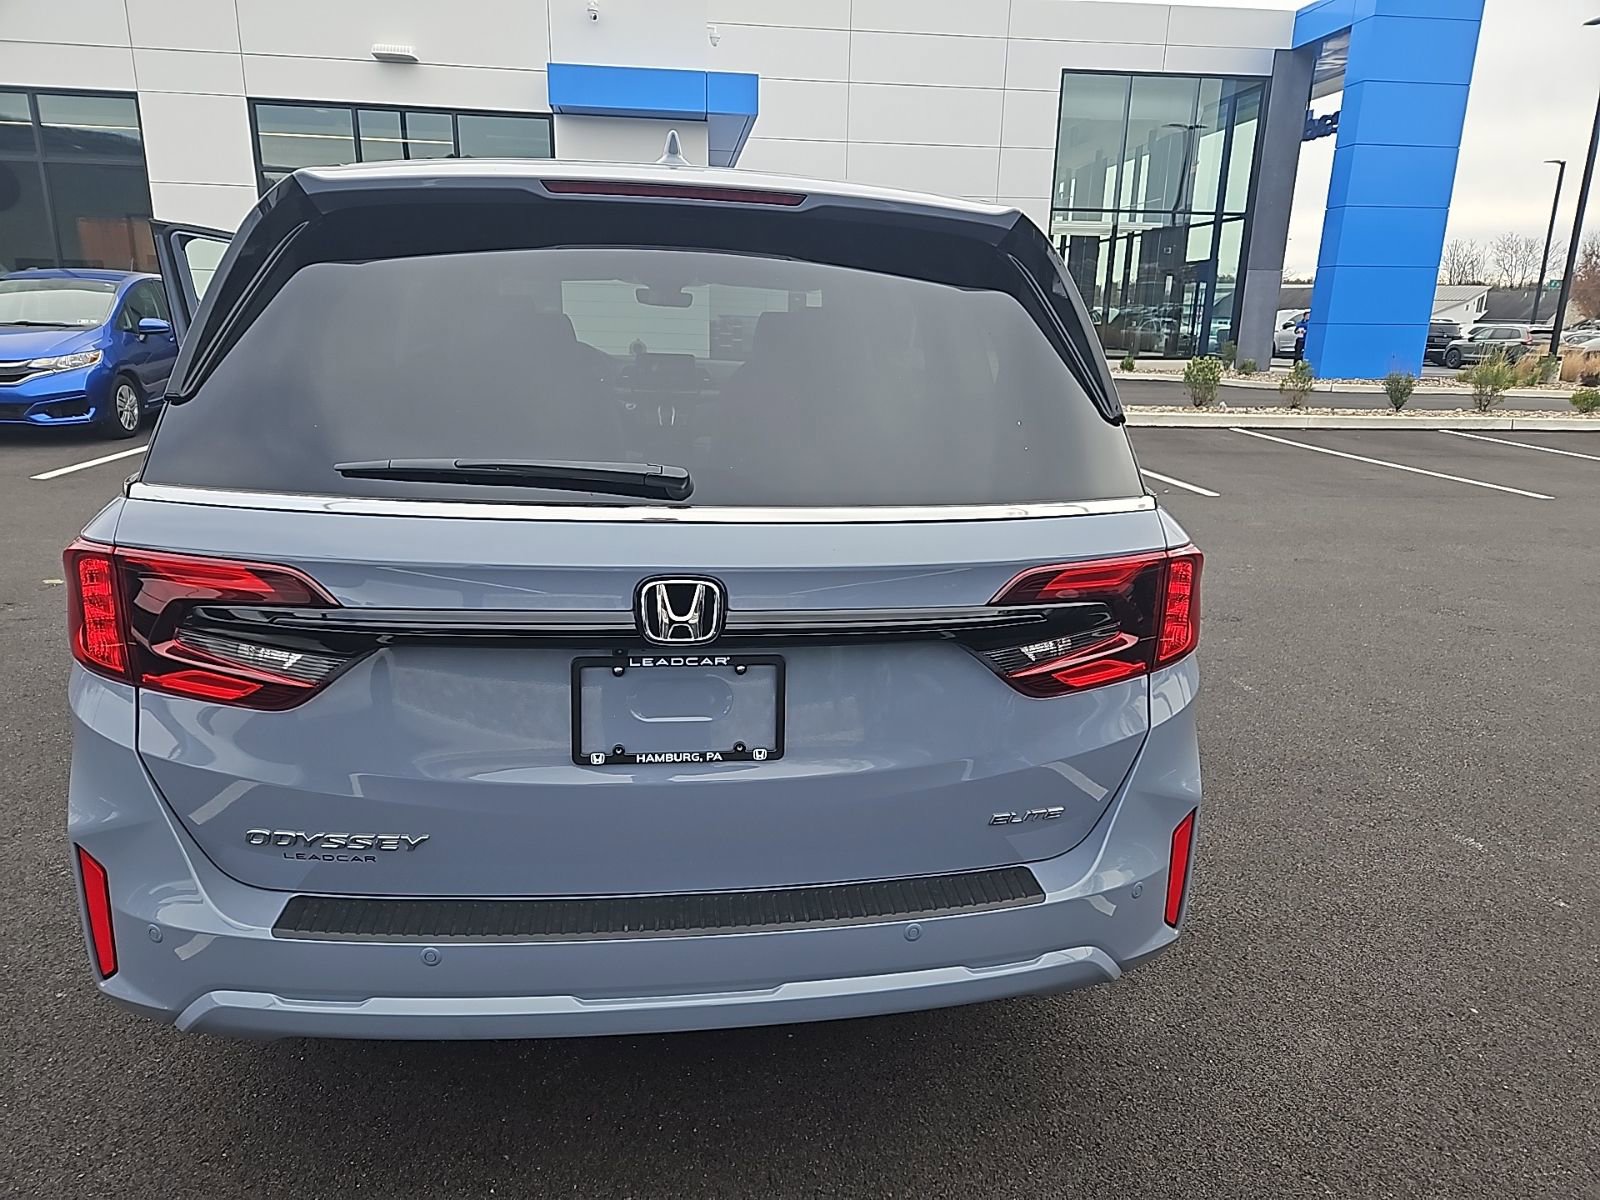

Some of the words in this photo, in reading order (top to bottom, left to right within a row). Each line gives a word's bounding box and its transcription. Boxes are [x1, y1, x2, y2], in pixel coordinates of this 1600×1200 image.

[629, 656, 730, 667] LEADCAR
[636, 753, 703, 763] HAMBURG,
[706, 752, 723, 762] PA
[988, 806, 1065, 825] ELITE
[245, 828, 430, 852] ODYSSEY
[283, 852, 377, 863] LEADCAR
